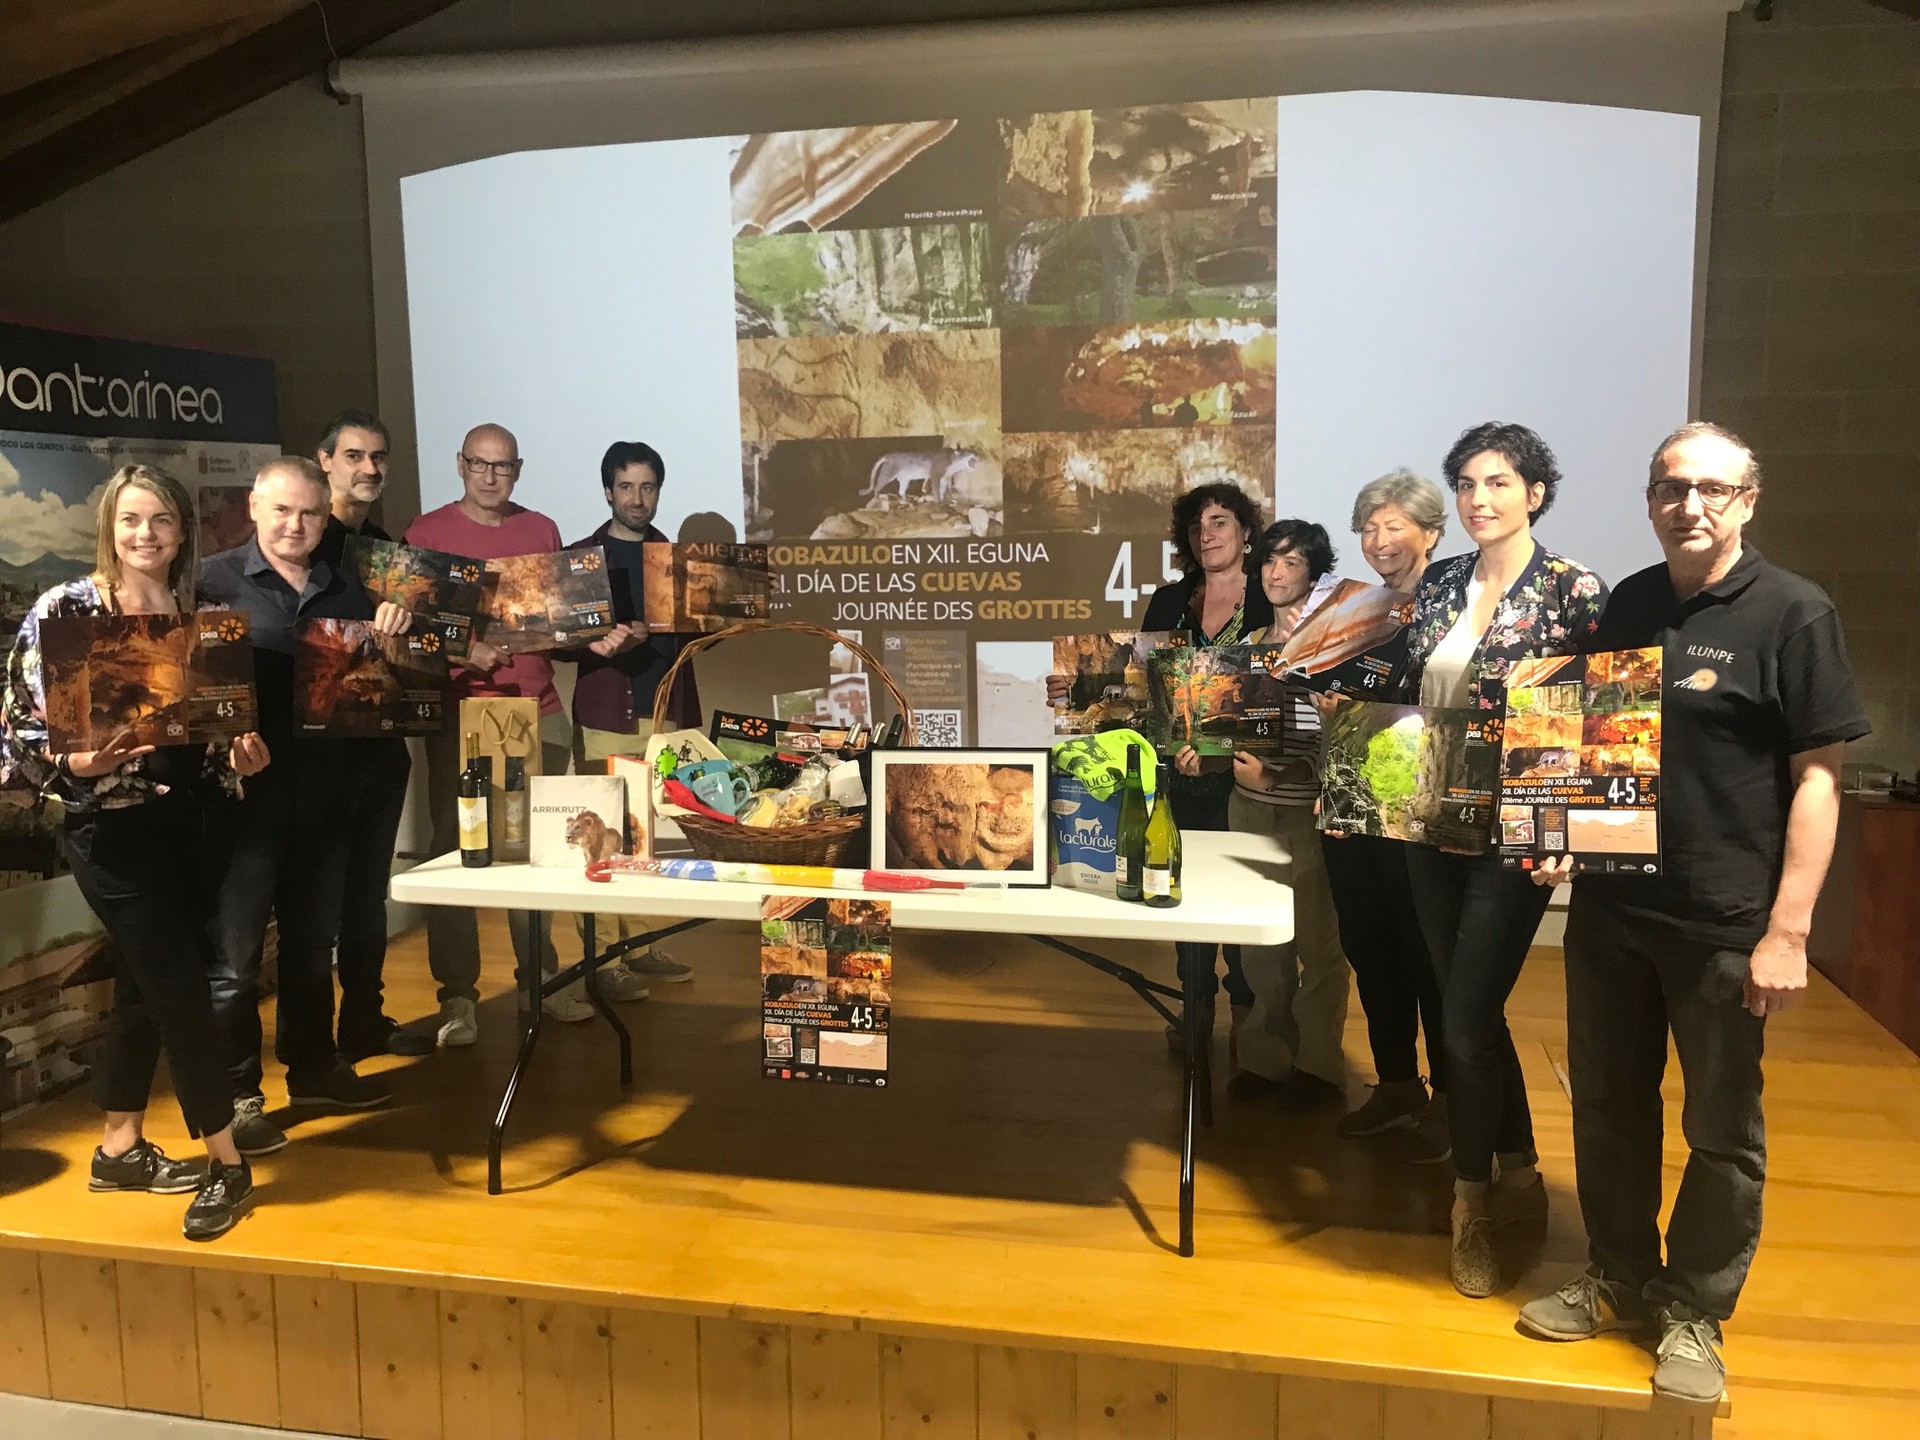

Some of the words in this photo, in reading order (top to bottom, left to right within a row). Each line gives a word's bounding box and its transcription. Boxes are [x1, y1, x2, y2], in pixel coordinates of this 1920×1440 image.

[927, 544, 961, 564] XII.
[967, 542, 1050, 564] EGUNA
[797, 568, 836, 594] DÍA
[841, 573, 871, 593] DE
[876, 572, 917, 593] LAS
[921, 571, 1023, 593] CUEVAS
[833, 597, 928, 621] JOURNÉE
[934, 601, 974, 621] DES
[978, 599, 1093, 620] GROTTES
[588, 613, 601, 626] 4-5
[1686, 644, 1736, 664] ILUNPE
[217, 701, 235, 718] 4-5
[417, 703, 431, 718] 4-5
[720, 722, 740, 731] pea
[1256, 721, 1269, 736] 4-5
[1465, 730, 1482, 739] pea
[1503, 778, 1554, 787] KOBAZULOEN
[1567, 777, 1593, 786] EGUNA
[1513, 786, 1527, 795] DÍA
[1552, 787, 1584, 795] CUEVAS
[1608, 777, 1636, 805] 4-5
[1523, 795, 1555, 804] JOURNÉE
[1568, 796, 1606, 804] GROTTES
[532, 805, 587, 814] ARRIKRUTZ
[1459, 806, 1476, 824] 4-5
[1059, 830, 1117, 849] lacturale
[1080, 872, 1101, 880] ENTERA
[806, 1011, 832, 1019] CUEVAS
[818, 1004, 839, 1012] EGUNA
[808, 1018, 820, 1026] DES
[820, 1019, 849, 1028] GROTTES
[851, 1006, 873, 1029] 4-5
